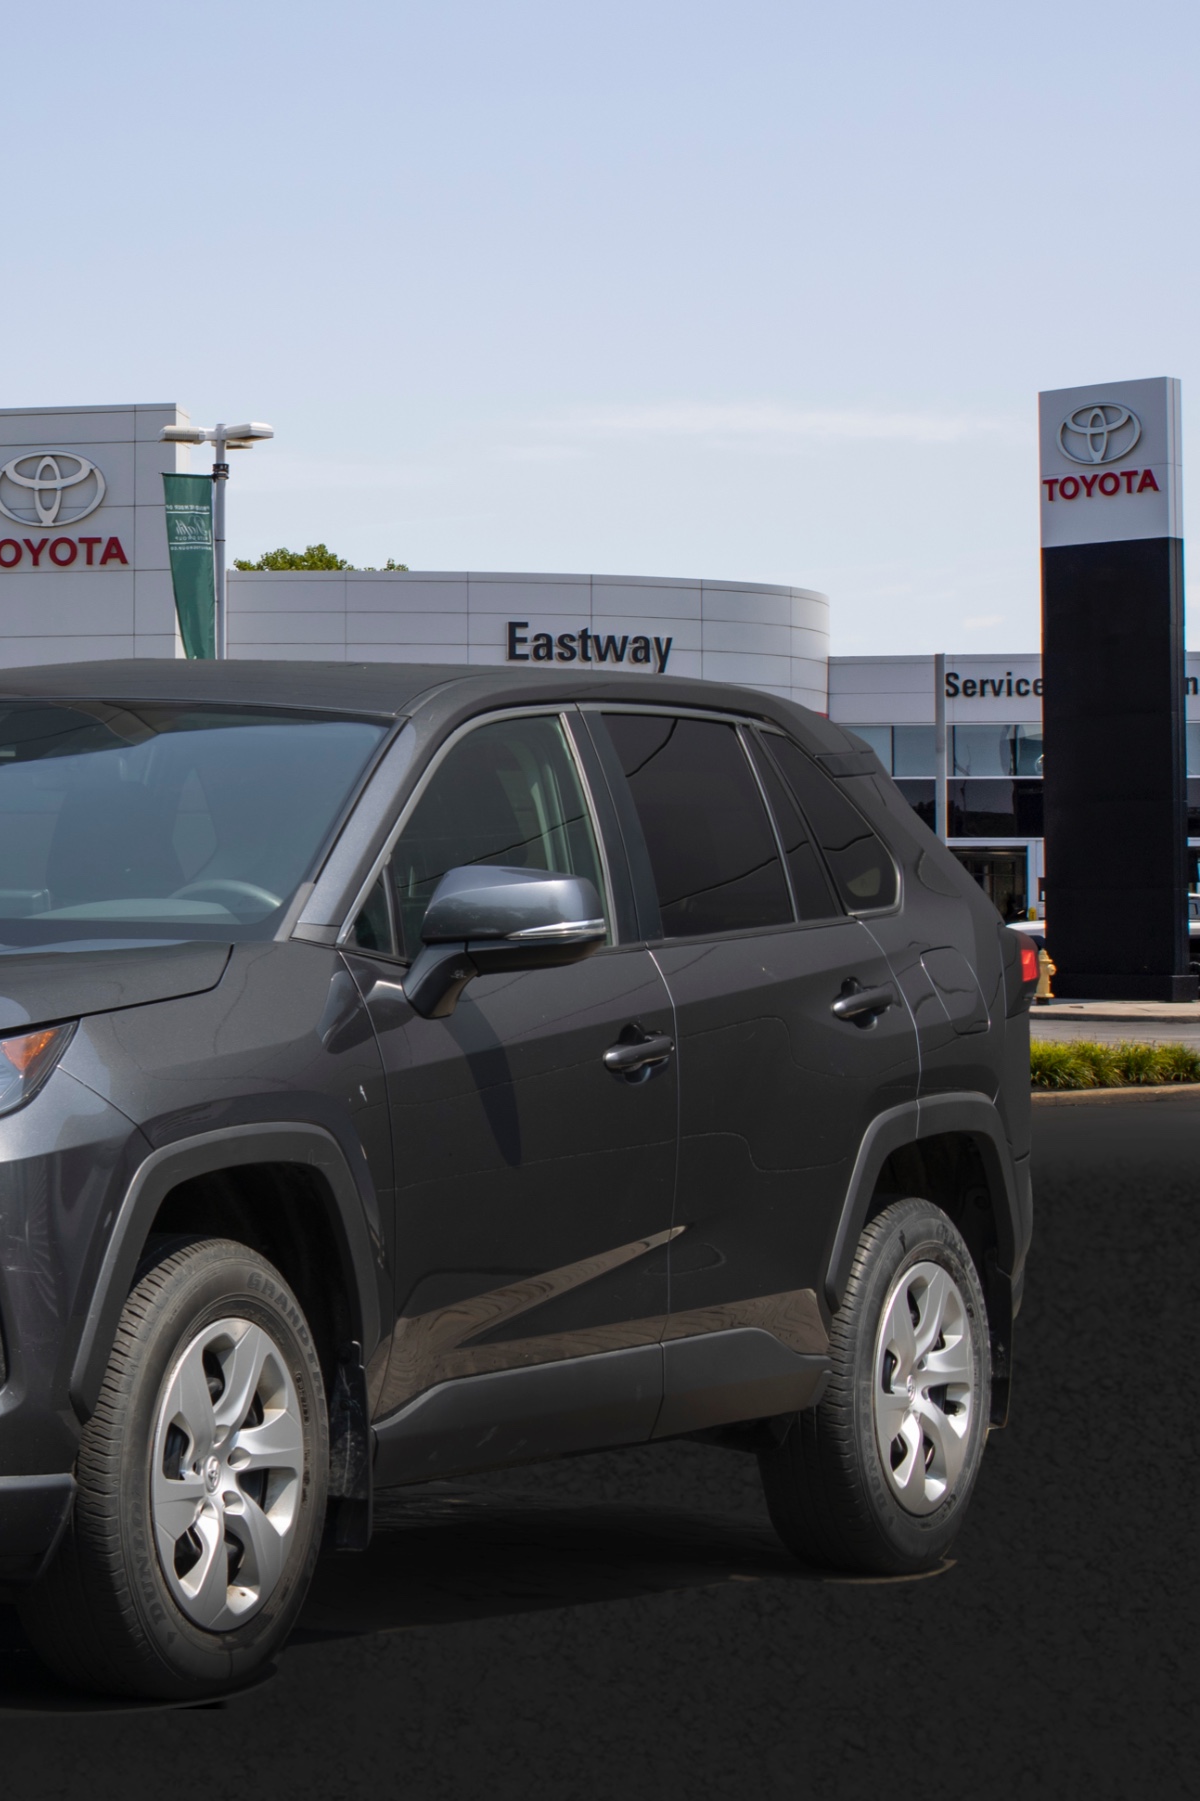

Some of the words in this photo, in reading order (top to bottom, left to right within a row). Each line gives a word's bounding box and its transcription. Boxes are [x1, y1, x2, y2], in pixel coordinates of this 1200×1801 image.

[1042, 469, 1160, 501] TOYOTA
[507, 621, 672, 673] Eastway
[945, 671, 1044, 697] Service
